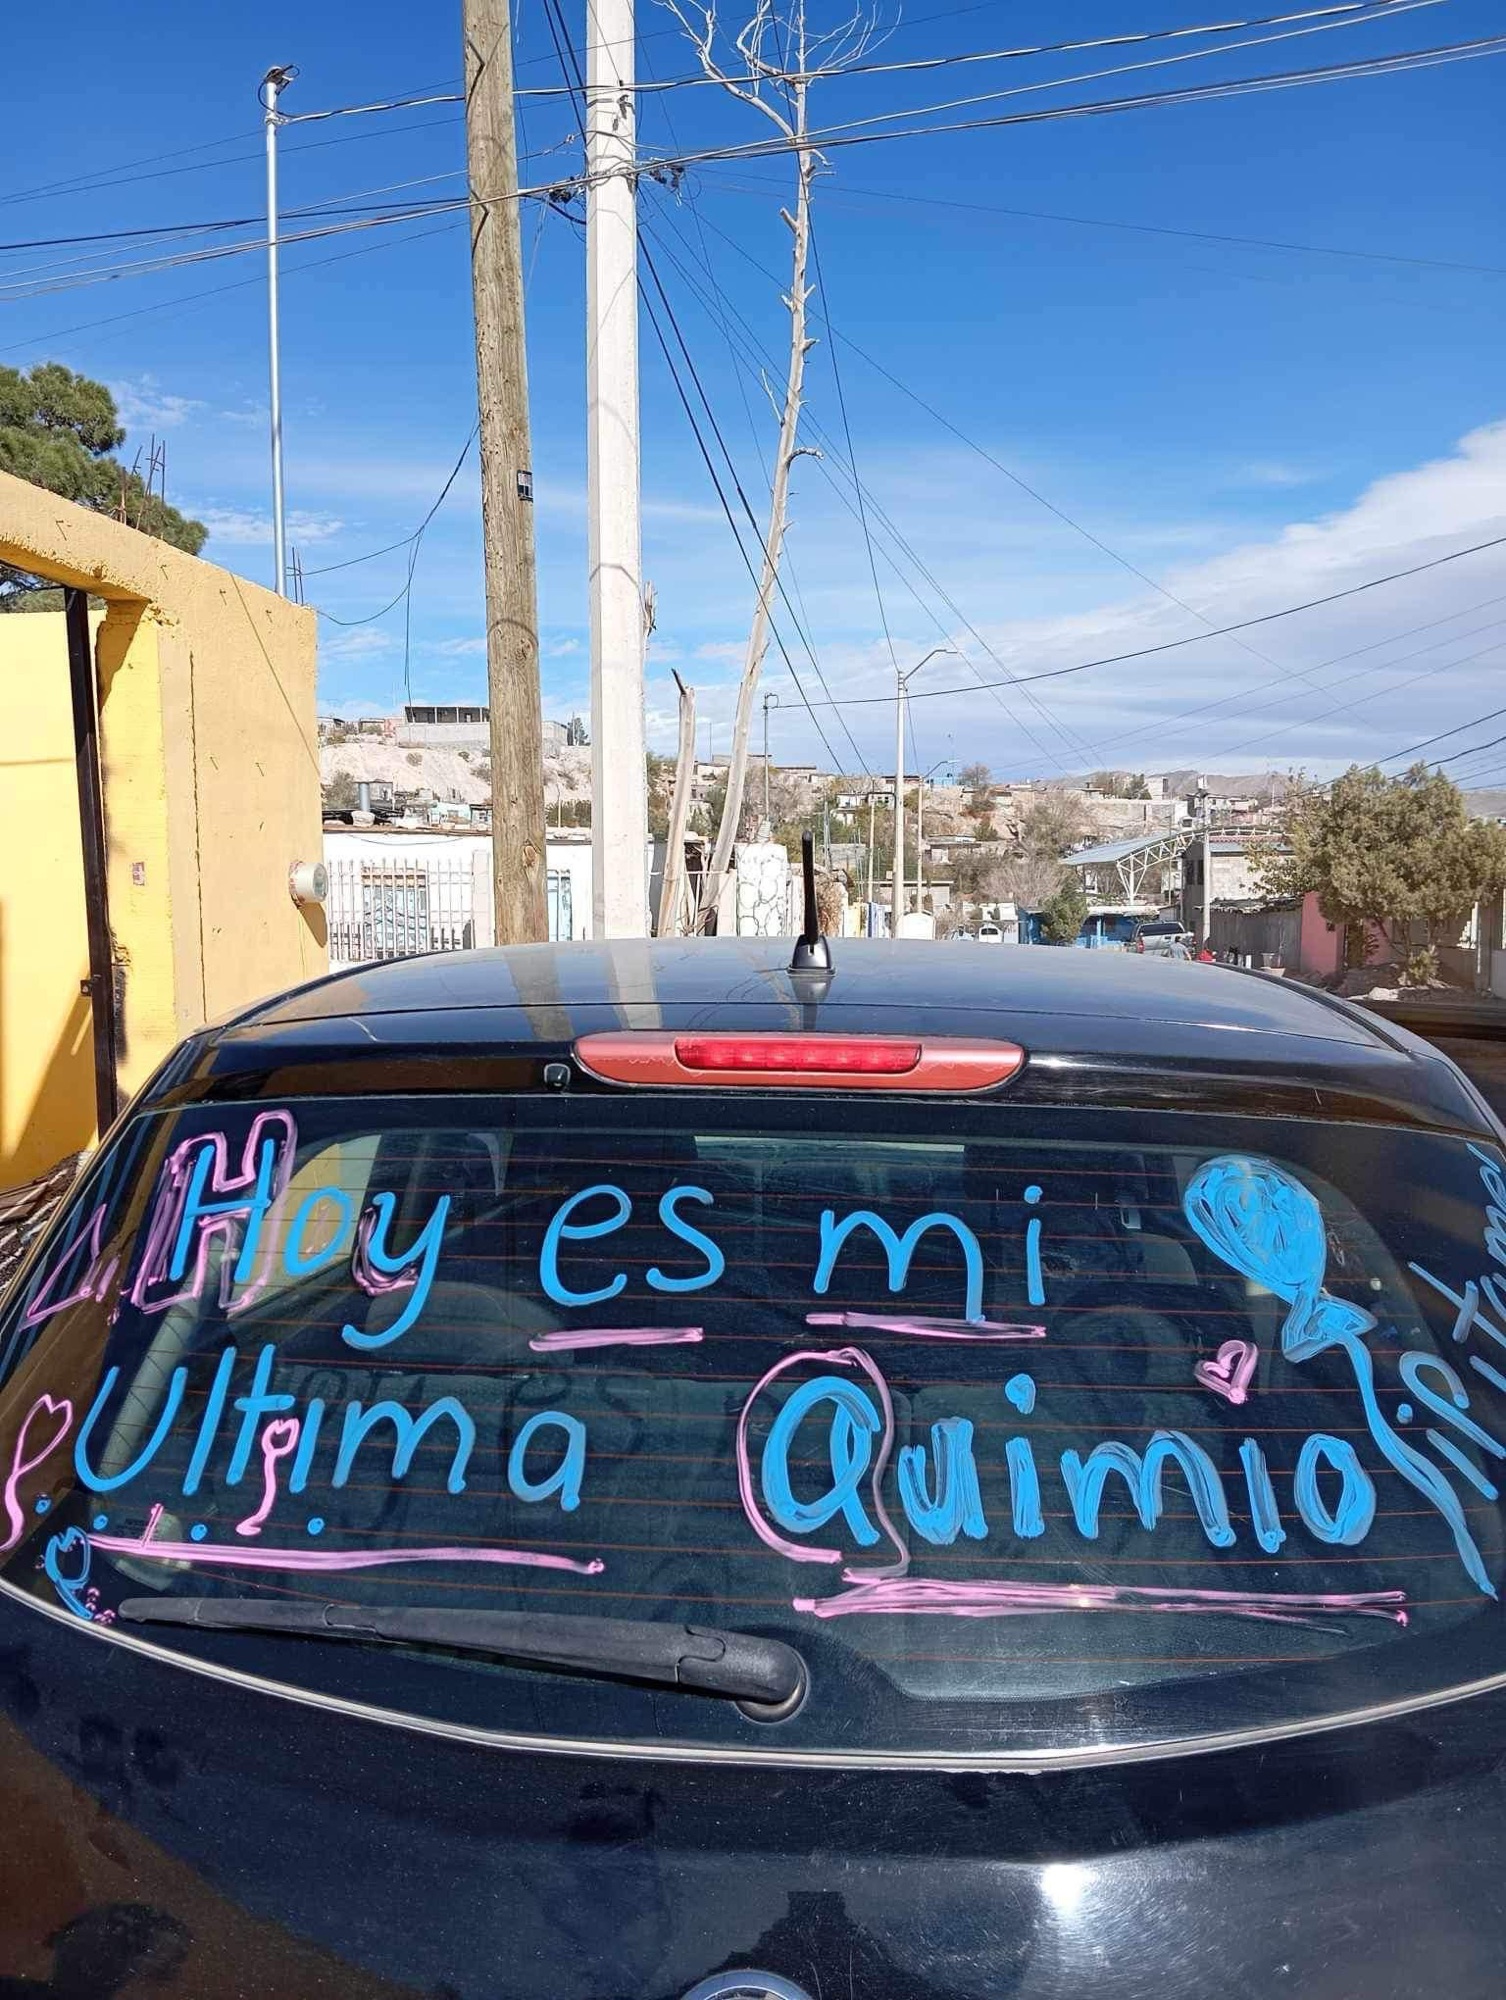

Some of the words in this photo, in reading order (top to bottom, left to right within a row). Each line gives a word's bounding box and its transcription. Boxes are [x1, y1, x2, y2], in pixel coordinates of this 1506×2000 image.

[166, 1136, 452, 1350] Hoy
[540, 1184, 727, 1307] es
[813, 1184, 1046, 1322] mi
[74, 1344, 588, 1512] Ultima
[761, 1364, 1378, 1555] Quimio
